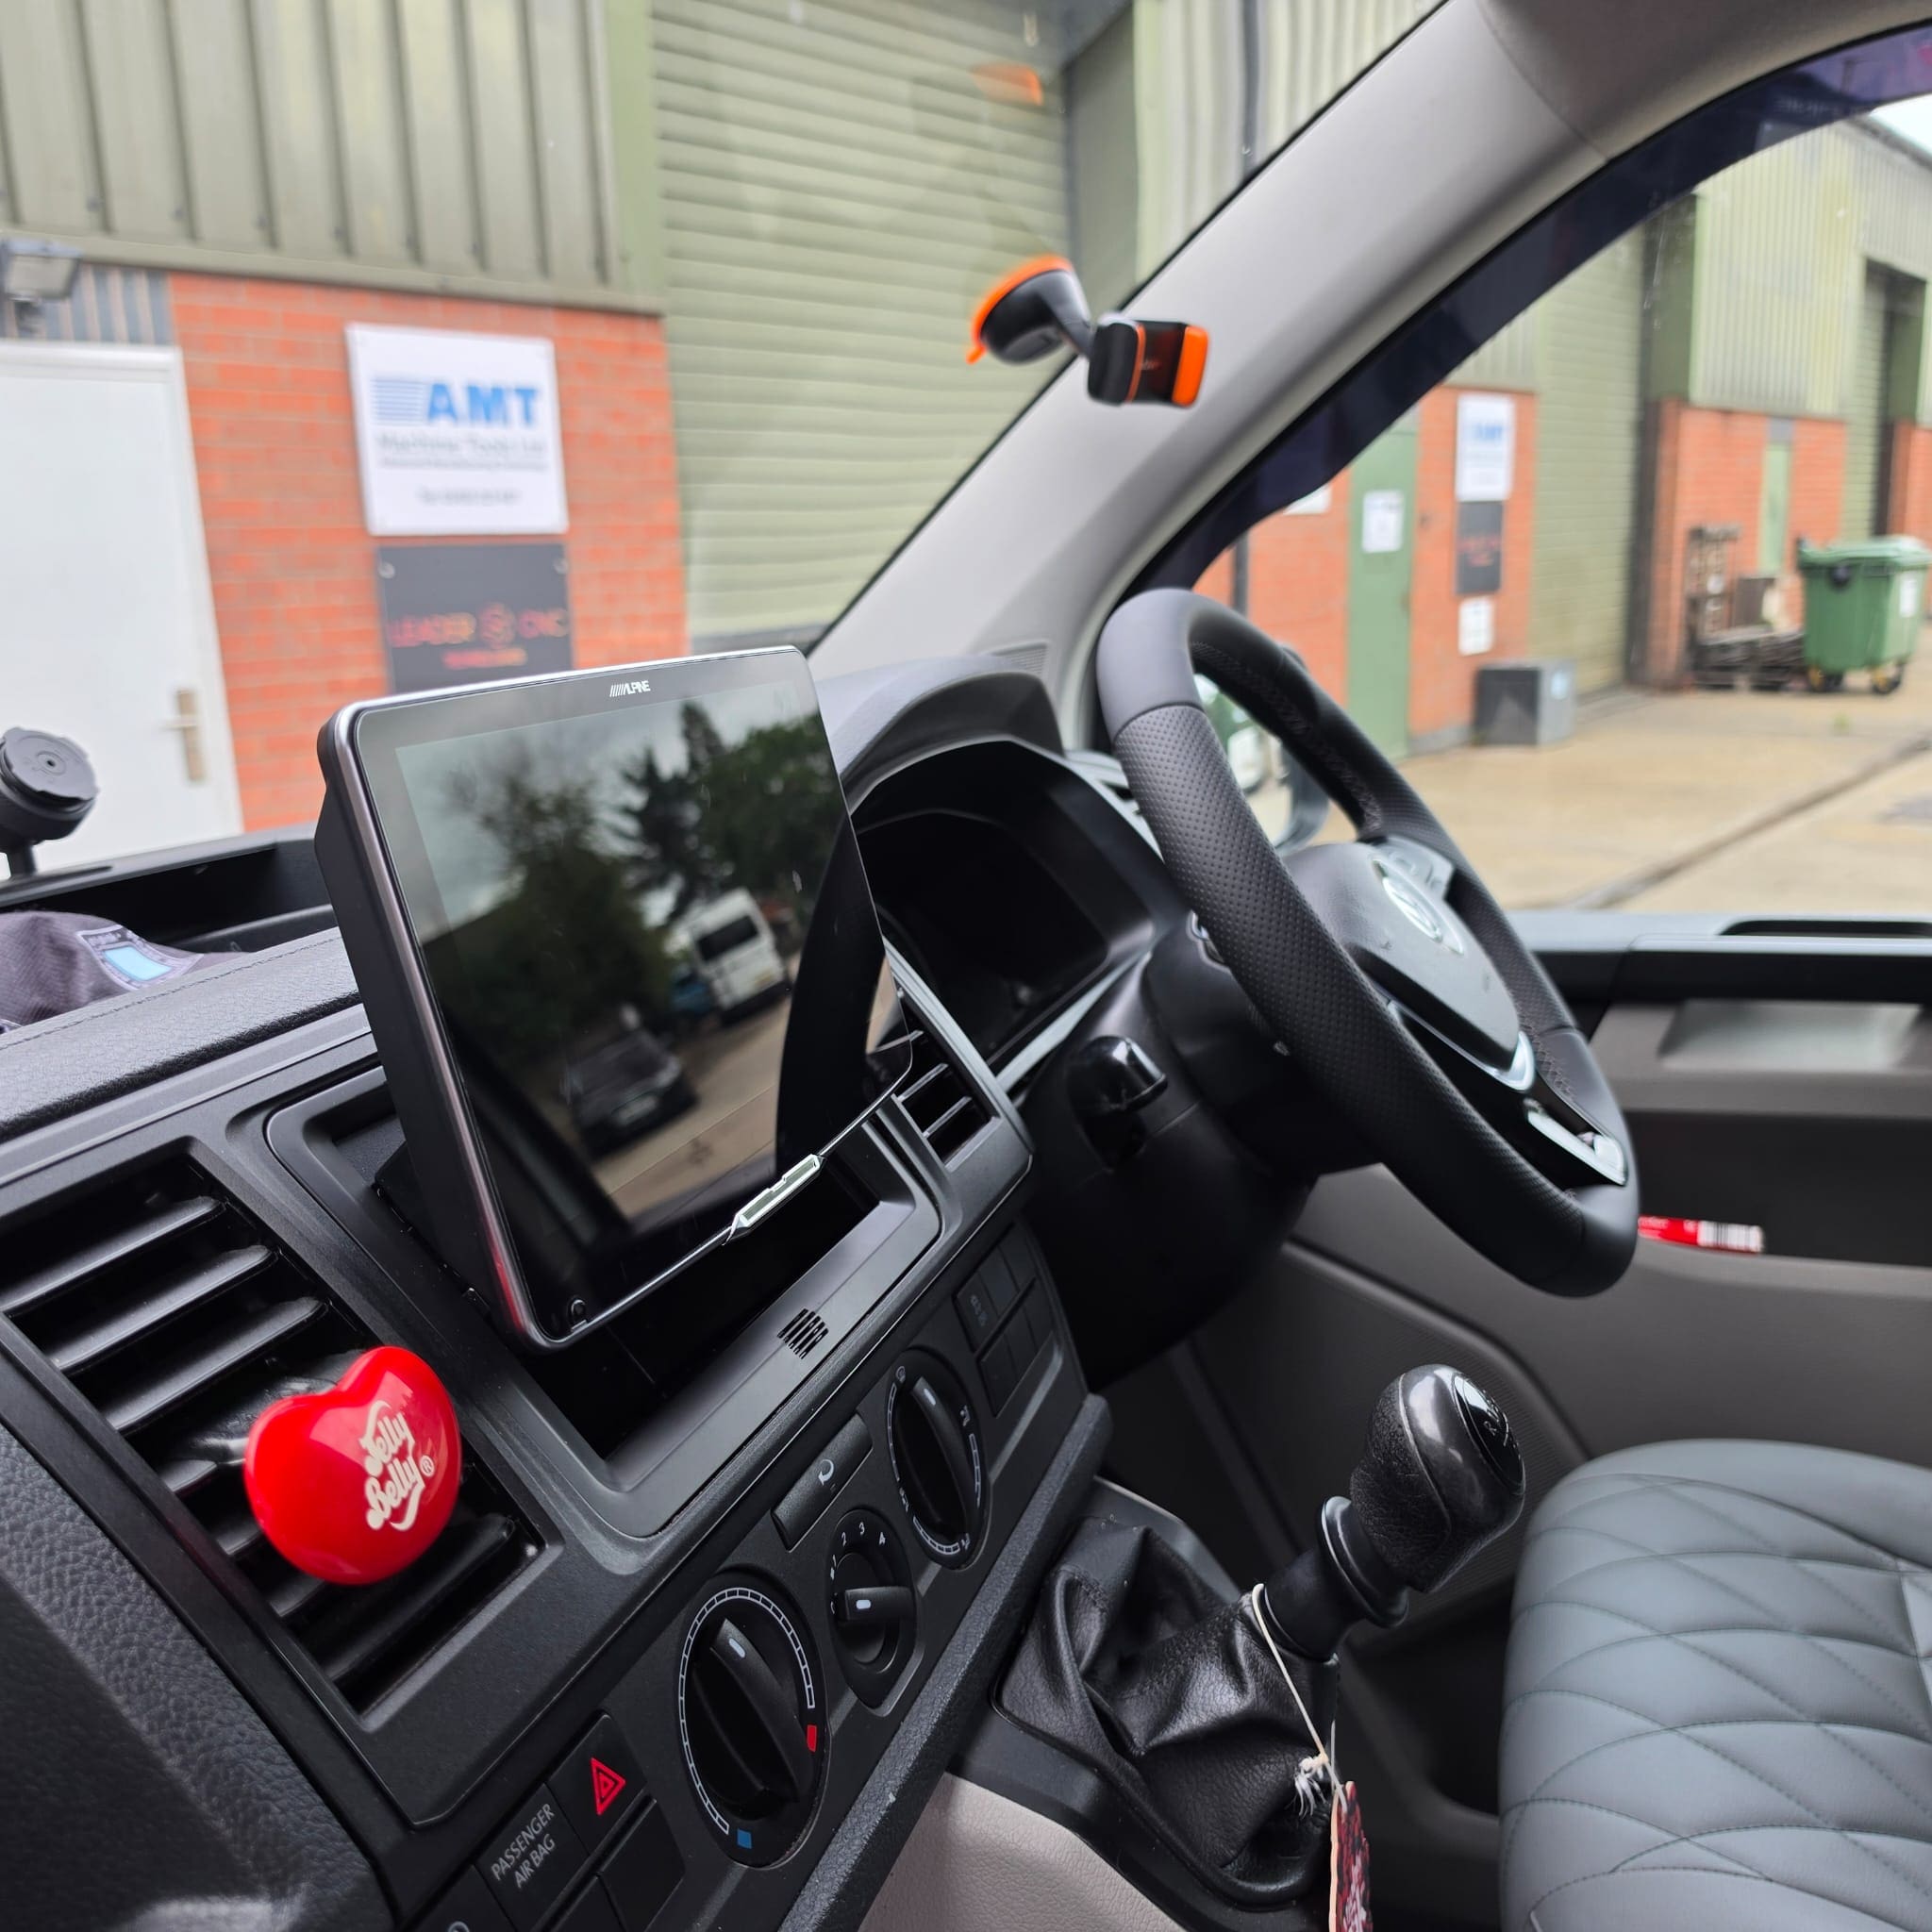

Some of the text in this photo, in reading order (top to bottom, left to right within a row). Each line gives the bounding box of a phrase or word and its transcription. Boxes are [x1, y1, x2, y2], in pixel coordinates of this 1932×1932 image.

[427, 382, 538, 427] AMT
[358, 1400, 415, 1476] Jelly
[858, 1522, 865, 1536] 3
[491, 1803, 555, 1881] PASSENGER
[514, 1833, 556, 1890] AIR BAG
